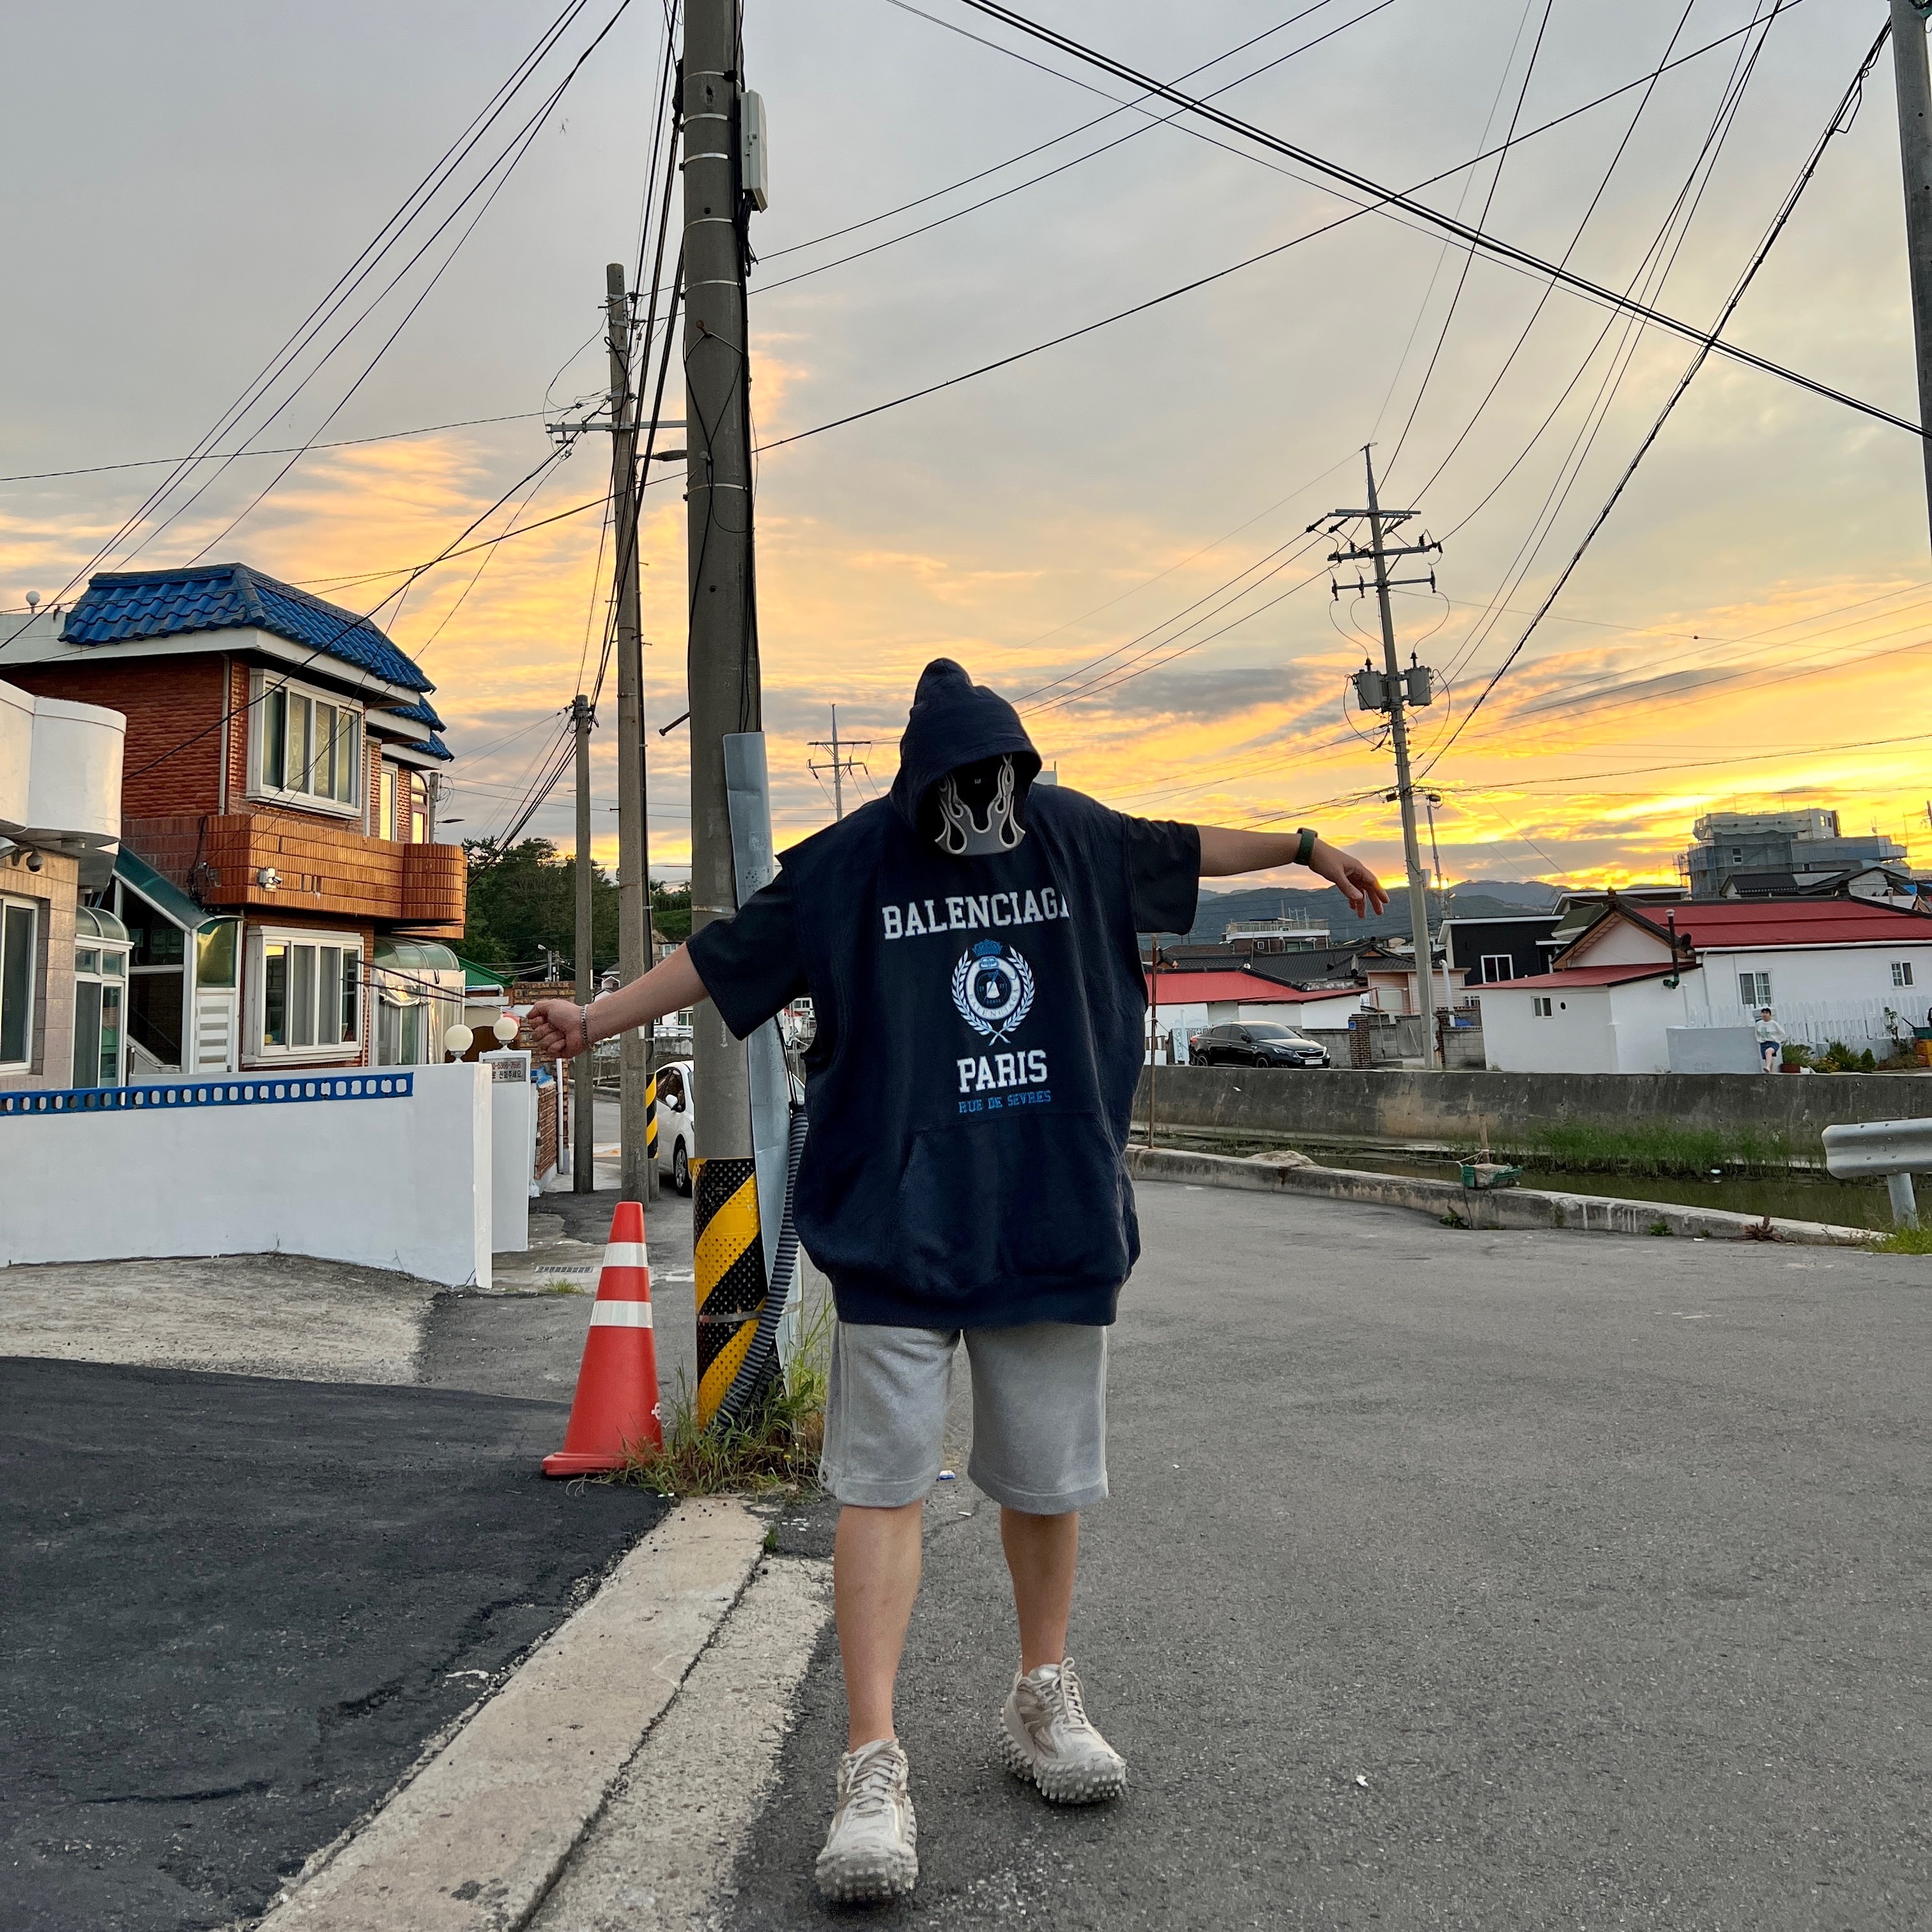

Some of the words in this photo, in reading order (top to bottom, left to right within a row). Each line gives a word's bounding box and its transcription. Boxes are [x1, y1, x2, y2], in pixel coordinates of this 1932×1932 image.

[499, 1070, 521, 1078] 전화주세요
[957, 1049, 1048, 1092] PARIS
[958, 1099, 983, 1113] RUE
[988, 1096, 1003, 1110] DE
[1007, 1090, 1052, 1107] SEVRES
